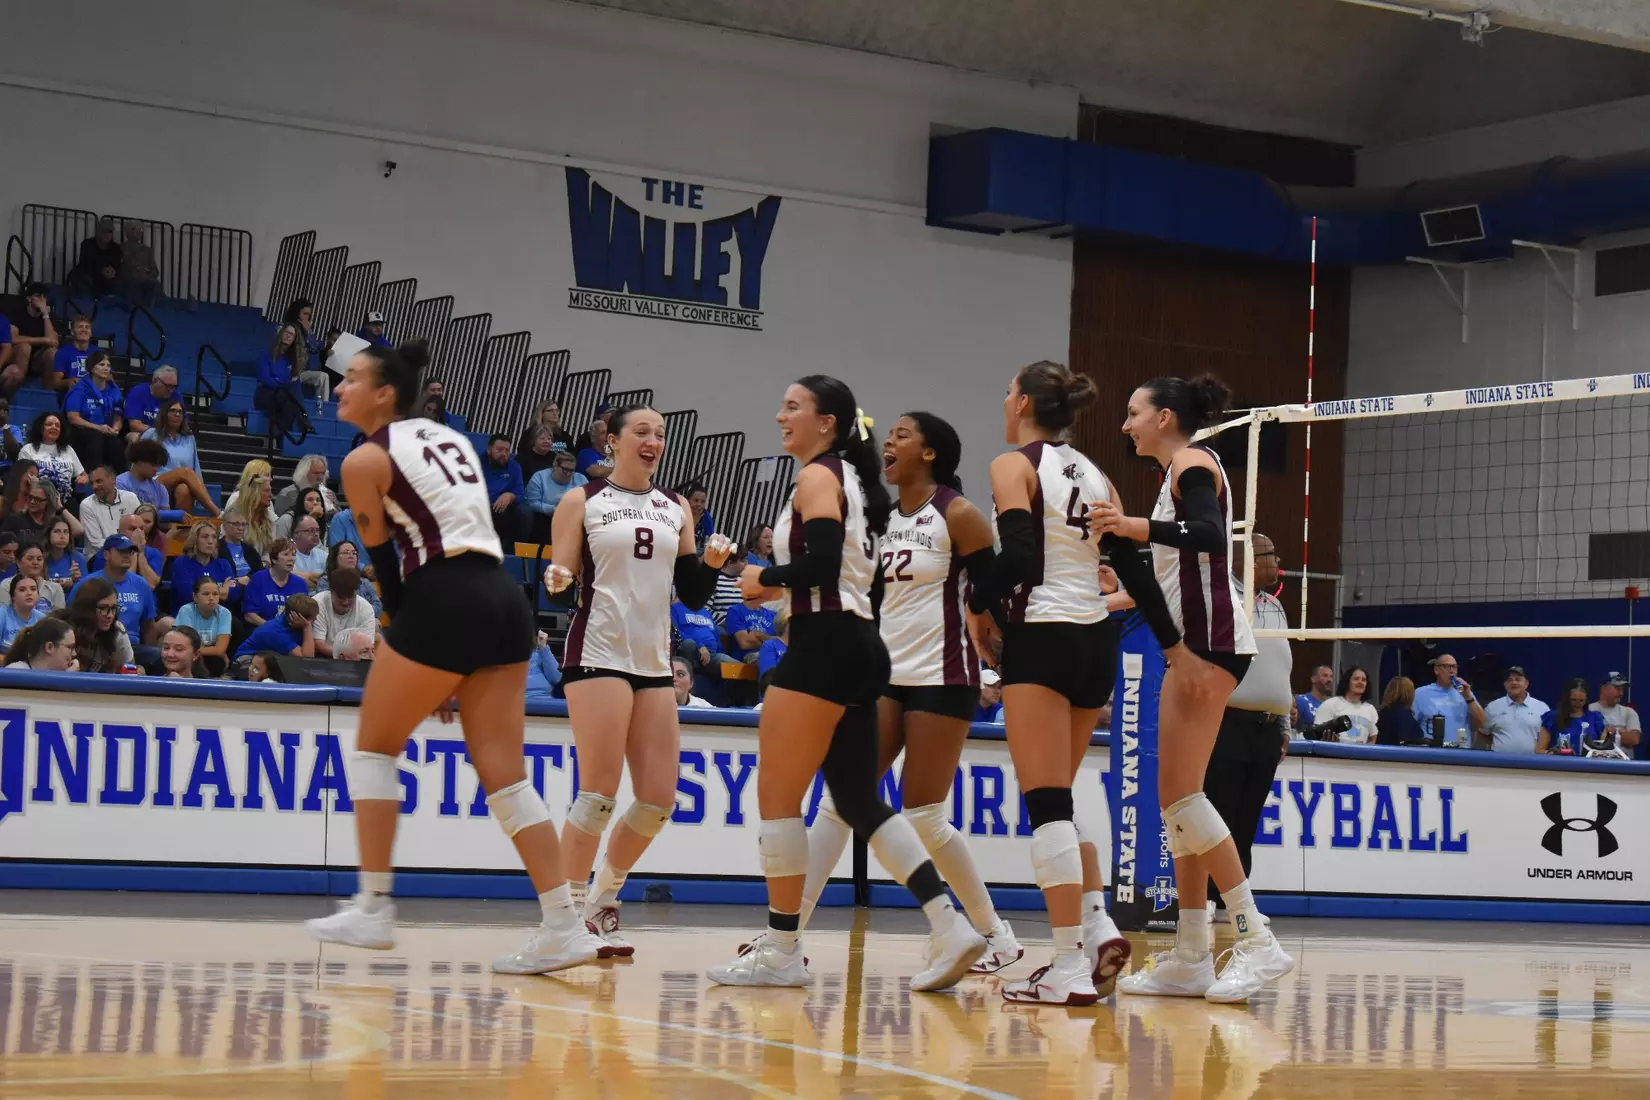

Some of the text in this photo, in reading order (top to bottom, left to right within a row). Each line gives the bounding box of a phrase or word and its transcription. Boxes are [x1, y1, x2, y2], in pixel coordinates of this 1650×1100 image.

[641, 177, 704, 210] THE
[565, 166, 782, 310] VALLEY
[569, 292, 759, 327] MISSOURI VALLEY CONFERENCE
[1314, 397, 1394, 417] INDIANA STATE
[1465, 382, 1553, 404] INDIANA STATE
[423, 442, 479, 486] 13
[602, 508, 644, 526] SOUTHERN
[1066, 486, 1093, 541] 4
[634, 527, 654, 559] 8
[883, 549, 913, 583] 22
[398, 736, 580, 817] STT
[1117, 651, 1143, 903] INDIANA STATE
[1527, 867, 1633, 882] UNDER ARMOUR
